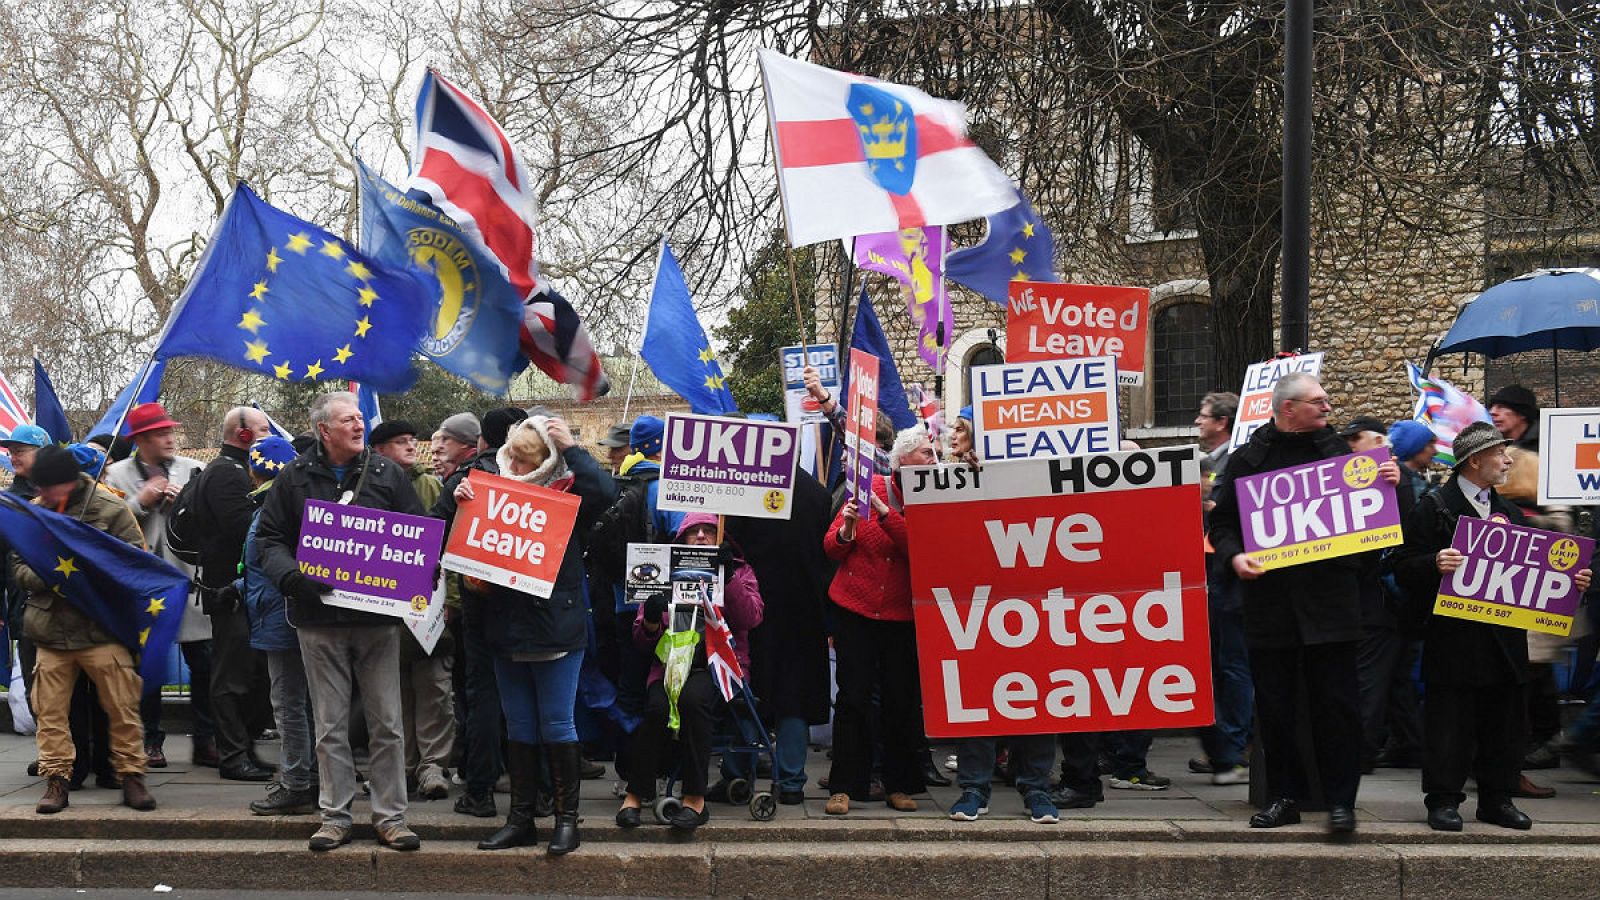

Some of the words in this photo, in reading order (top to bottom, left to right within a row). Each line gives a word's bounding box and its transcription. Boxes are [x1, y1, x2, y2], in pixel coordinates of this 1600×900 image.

[1009, 288, 1038, 316] WE
[1028, 325, 1124, 358] Leave
[784, 352, 835, 368] STOP
[981, 362, 1107, 396] LEAVE
[1119, 375, 1138, 384] trol
[852, 394, 873, 431] Lave
[998, 400, 1092, 424] MEANS
[671, 419, 792, 467] UKIP
[984, 427, 1109, 460] LEAVE
[669, 463, 786, 484] #BritainTogether
[912, 467, 984, 493] JUST
[1048, 448, 1194, 494] HOOT
[1246, 462, 1340, 510] VOTE
[666, 481, 691, 492] 0333
[693, 483, 714, 494] 800
[725, 486, 745, 497] 800
[666, 493, 705, 505] ukip.org
[308, 506, 334, 525] We
[341, 514, 386, 534] want
[391, 523, 425, 540] our
[487, 489, 548, 533] Vote
[1250, 488, 1385, 549] UKIP
[302, 535, 376, 562] country
[381, 543, 426, 567] back
[466, 517, 545, 564] Leave
[984, 513, 1104, 568] we
[1360, 532, 1398, 545] ukip.org
[1467, 522, 1547, 566] VOTE
[299, 560, 330, 578] Vote
[335, 567, 350, 581] to
[355, 570, 398, 590] Leave
[680, 583, 714, 591] LEAE
[1452, 555, 1572, 610] UKIP
[681, 592, 696, 600] the
[932, 571, 1184, 650] Voted
[1440, 599, 1465, 610] 0800
[1466, 604, 1484, 615] 587
[1487, 607, 1493, 615] 6
[1495, 608, 1512, 618] 587
[1535, 616, 1568, 630] ukip.org
[941, 660, 1196, 723] Leave
